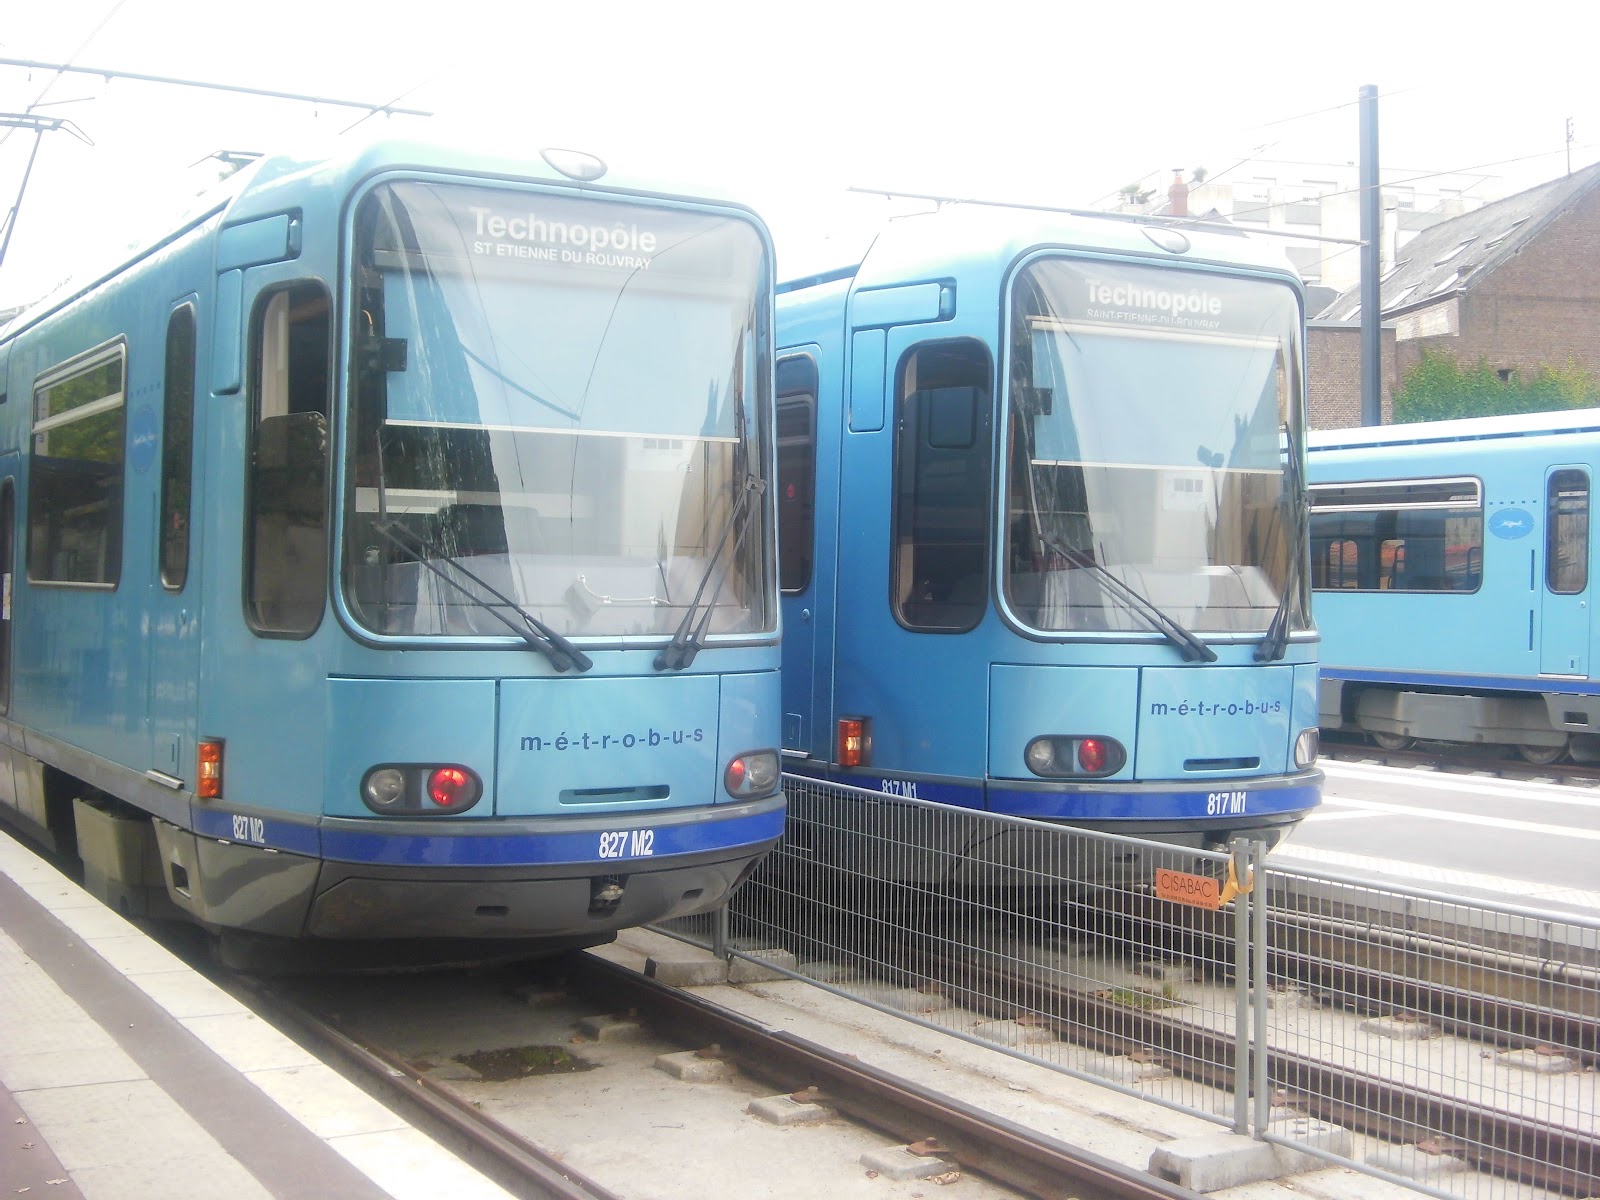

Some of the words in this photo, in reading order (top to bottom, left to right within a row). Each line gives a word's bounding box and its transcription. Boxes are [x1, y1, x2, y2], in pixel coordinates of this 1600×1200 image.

[469, 206, 657, 252] Technopôle
[474, 241, 493, 255] ST
[496, 244, 558, 261] ETIENNE
[562, 250, 582, 263] DU
[586, 253, 651, 270] ROUVRAY
[1085, 278, 1222, 317] Technopôle
[1151, 699, 1281, 716] m-é-t-r-o-b-u-s
[520, 727, 703, 751] m-é-t-r-o-b-u-s
[1207, 792, 1230, 815] 817
[1230, 791, 1247, 814] M1
[232, 814, 248, 840] 827
[249, 817, 265, 844] M2
[598, 831, 628, 858] 827
[630, 829, 654, 857] M2
[1161, 873, 1212, 898] CISABAC
